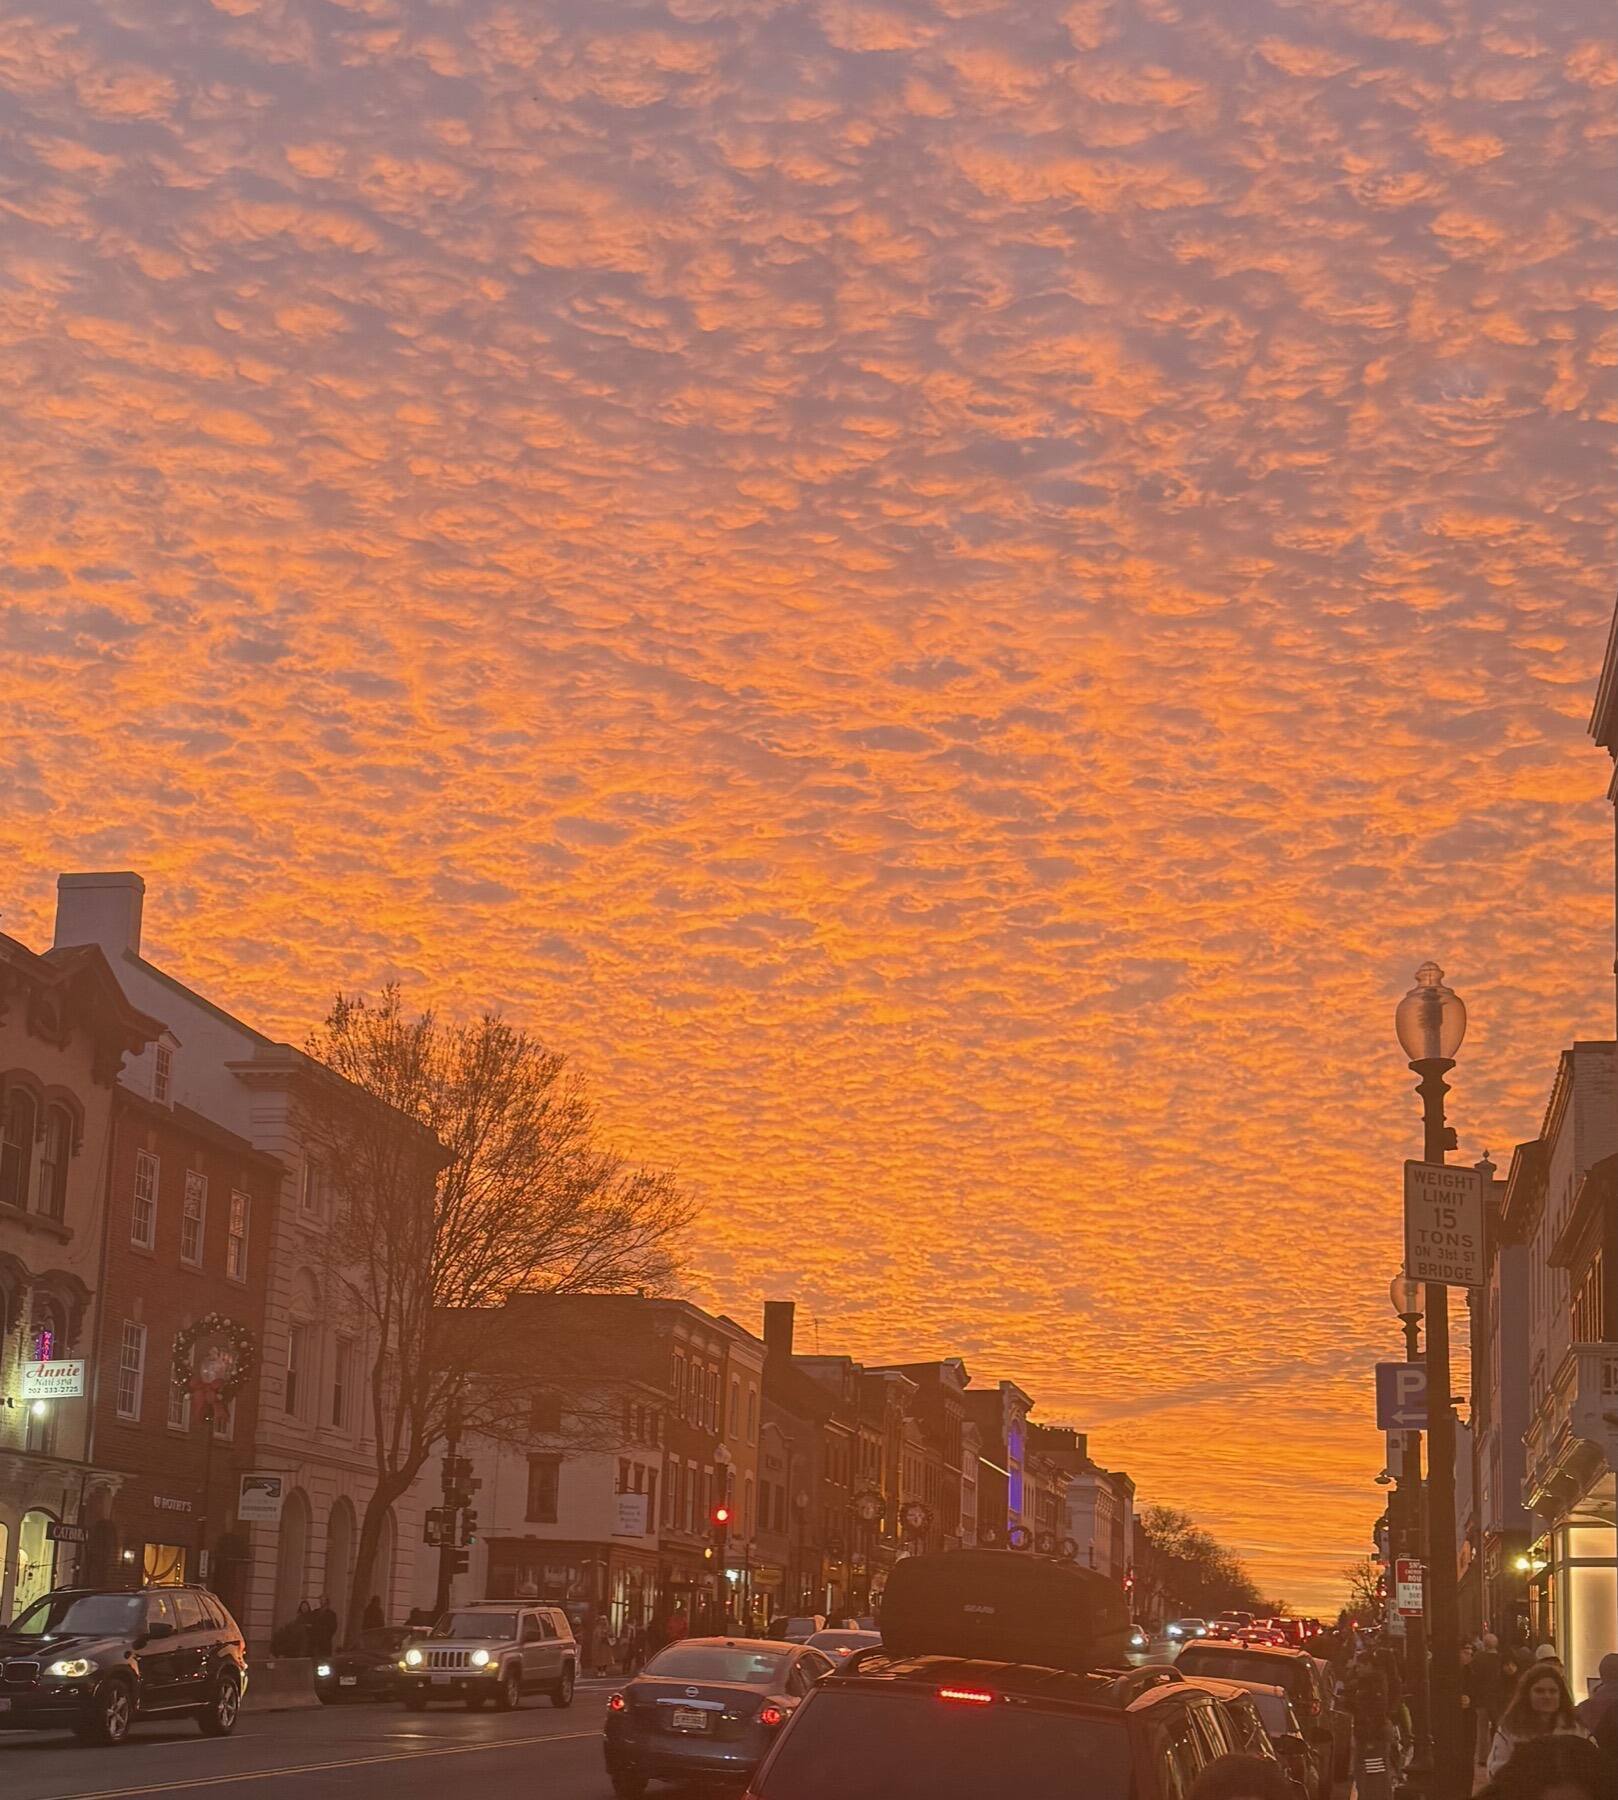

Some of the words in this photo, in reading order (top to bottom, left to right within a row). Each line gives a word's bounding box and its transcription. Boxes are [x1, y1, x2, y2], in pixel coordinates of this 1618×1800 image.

[1413, 1169, 1477, 1190] WEIGHT
[1422, 1189, 1467, 1206] LIMIT
[1433, 1207, 1457, 1230] 15
[1417, 1229, 1474, 1248] TONS
[1415, 1245, 1431, 1257] ON
[1437, 1247, 1458, 1260] 31st
[1463, 1251, 1476, 1263] ST
[1417, 1262, 1474, 1281] BRIDGE
[26, 1363, 81, 1379] Annie
[1395, 1369, 1428, 1406] P
